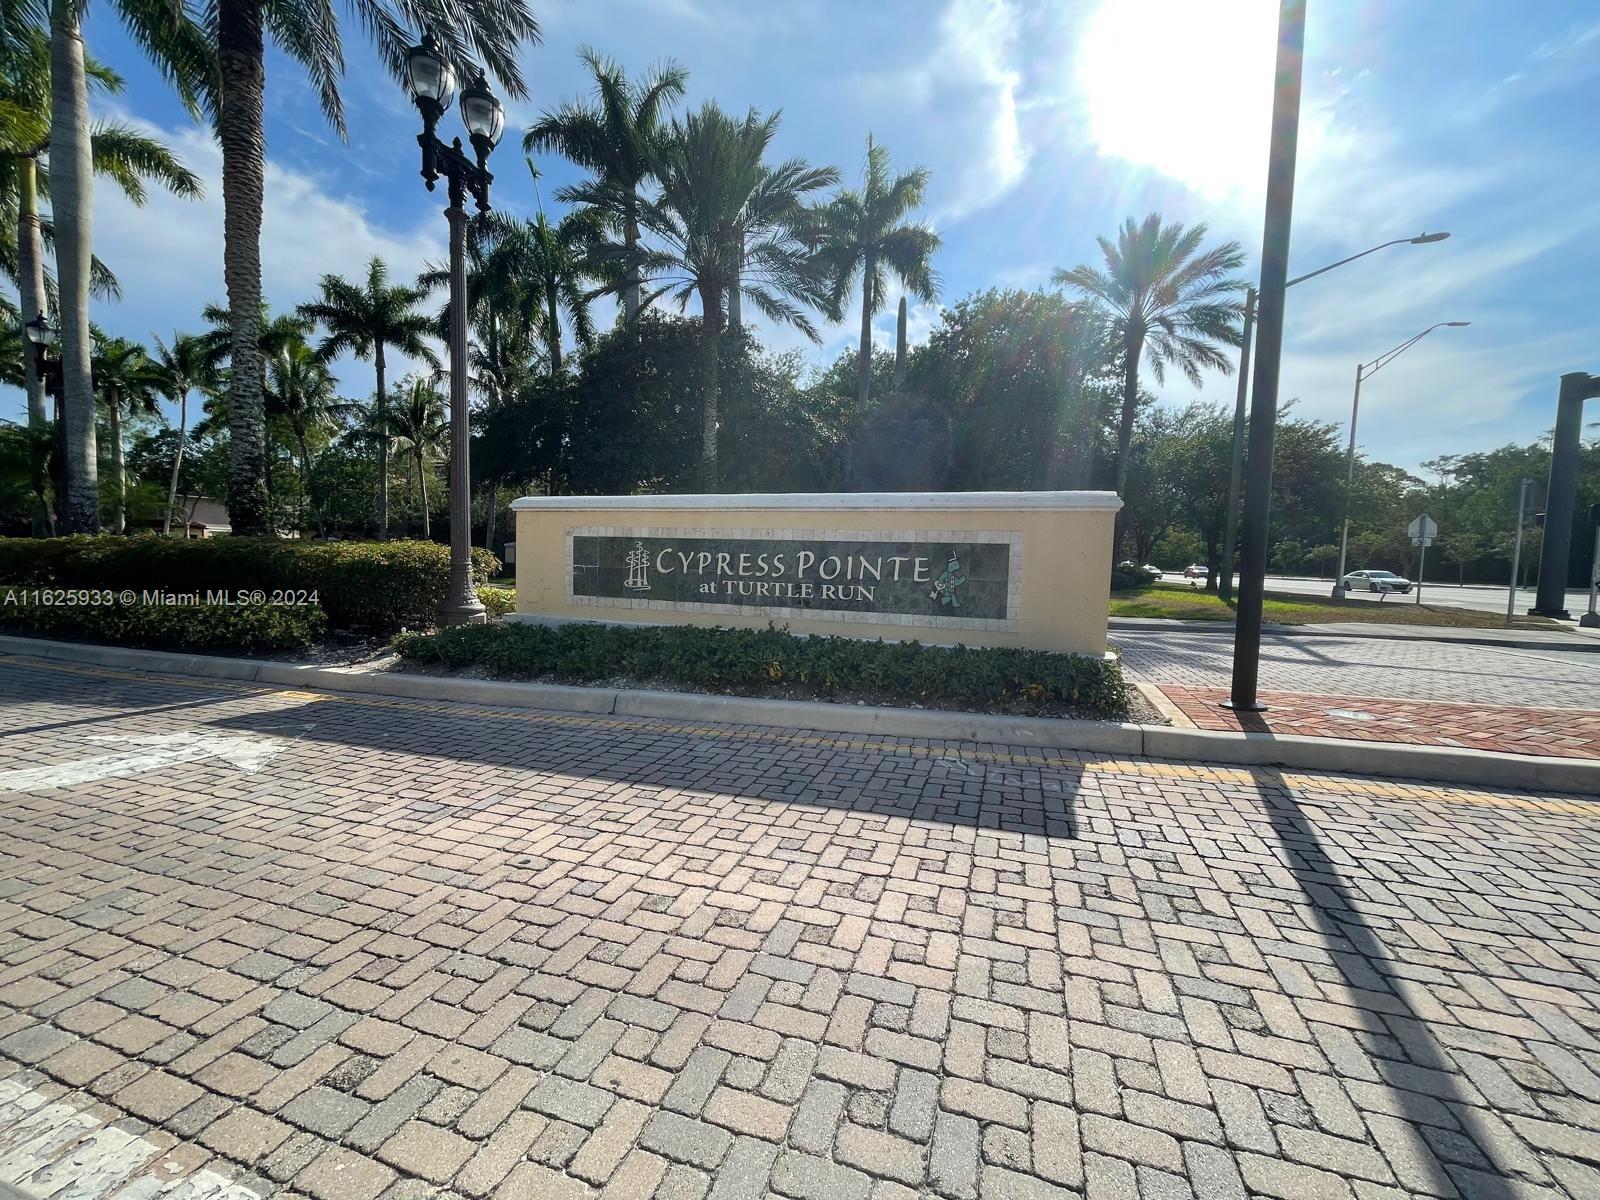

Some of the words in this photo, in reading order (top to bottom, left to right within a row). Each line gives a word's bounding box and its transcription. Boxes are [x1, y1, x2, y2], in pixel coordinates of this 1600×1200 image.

[656, 547, 786, 578] CYPRESS
[796, 550, 931, 583] POINTE
[699, 582, 718, 594] at
[722, 580, 815, 599] TURTLE
[820, 584, 876, 601] RUN
